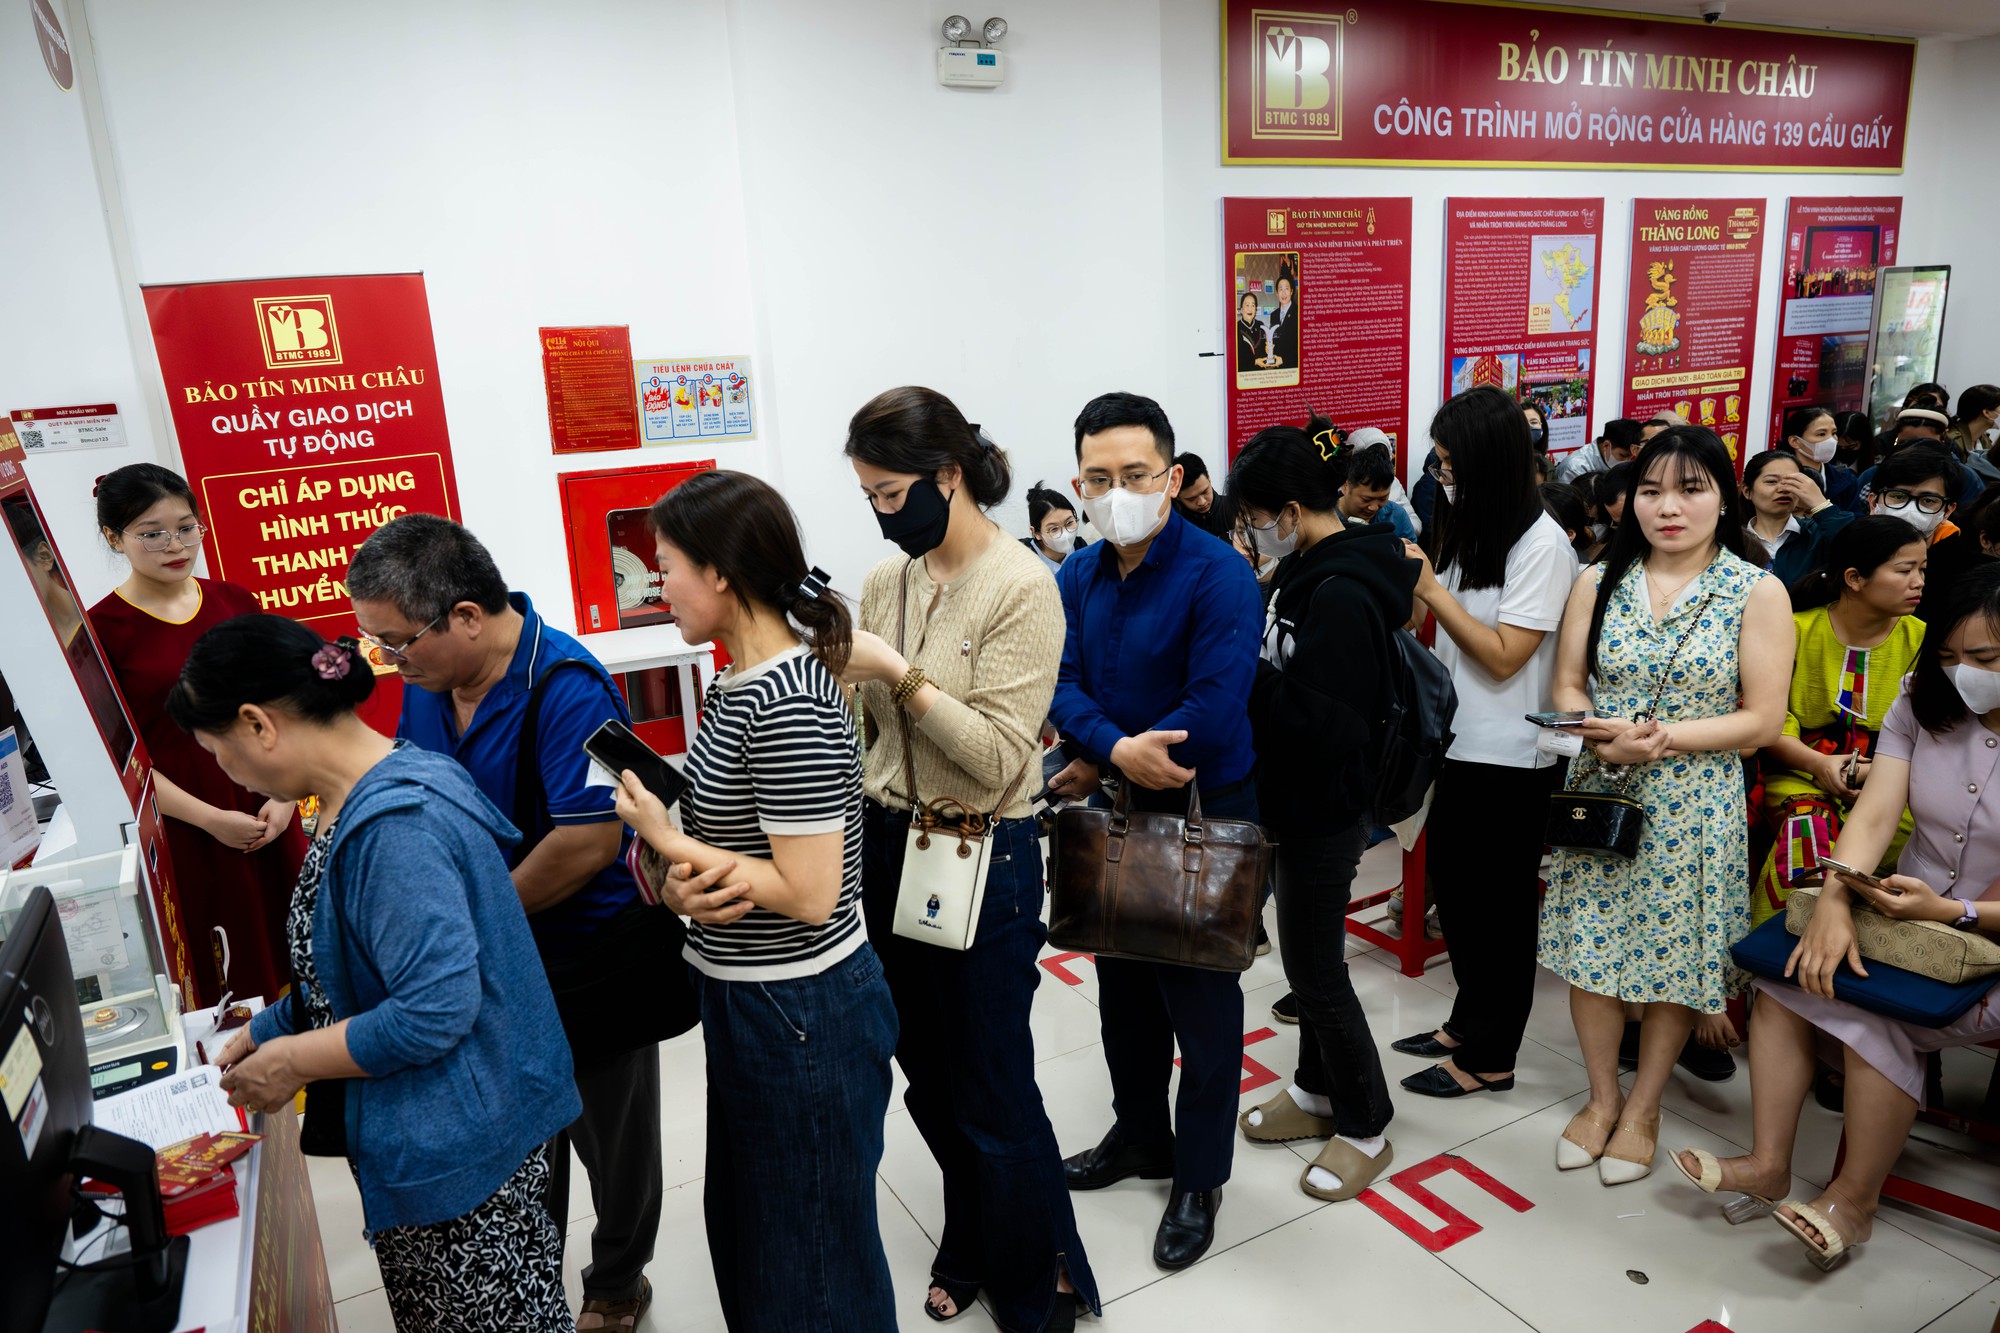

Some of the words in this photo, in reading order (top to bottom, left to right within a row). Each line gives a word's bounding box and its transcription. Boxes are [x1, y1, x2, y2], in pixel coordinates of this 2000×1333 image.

[1497, 29, 1569, 85] BẢO
[1577, 39, 1638, 93] TÍN
[1642, 52, 1733, 94] MINH
[1737, 53, 1818, 99] CHÂU
[1265, 111, 1298, 126] BTMC
[1301, 112, 1330, 127] 1989
[1373, 97, 1452, 137] CÔNG
[1460, 101, 1536, 139] TRÌNH
[1545, 101, 1582, 140] MỞ
[1588, 106, 1653, 147] RỘNG
[1659, 106, 1703, 144] CỬA
[1709, 112, 1766, 147] HÀNG
[1773, 121, 1803, 147] 139
[1808, 112, 1846, 149] CẦU
[1850, 115, 1893, 149] GIẤY
[1292, 209, 1308, 219] BẢO
[1309, 208, 1321, 219] TÍN
[1342, 208, 1363, 219] CHÂU
[1655, 207, 1681, 221] VÀNG
[1682, 204, 1709, 221] RỒNG
[1745, 218, 1758, 227] LONG
[1640, 223, 1684, 242] THĂNG
[1686, 225, 1720, 241] LONG
[1277, 241, 1293, 249] CHÂU
[1524, 342, 1536, 350] ĐIỂM
[276, 351, 304, 361] BTMC
[307, 349, 331, 359] 1989
[653, 365, 670, 374] TIÊU
[672, 364, 691, 374] LỆNH
[693, 362, 714, 372] CHỮA
[716, 361, 735, 371] CHÁY
[183, 380, 238, 404] BẢO
[242, 376, 285, 400] TÍN
[291, 374, 357, 395] MINH
[361, 365, 425, 390] CHÂU
[1634, 378, 1650, 387] GIAO
[1650, 377, 1665, 386] DỊCH
[1666, 376, 1678, 385] MỌI
[1636, 391, 1654, 401] NHẪN
[646, 400, 667, 411] ĐỘNG
[211, 403, 281, 435] QUẦY
[288, 406, 349, 428] GIAO
[355, 399, 414, 424] DỊCH
[263, 436, 298, 460] TỰ
[303, 430, 375, 455] ĐỘNG
[238, 478, 289, 509] CHỈ
[296, 476, 332, 503] ÁP
[338, 470, 416, 500] DỤNG
[259, 514, 330, 542] HÌNH
[334, 502, 407, 532] THỨC
[251, 546, 349, 577] THANH
[252, 573, 351, 610] HUYỂN
